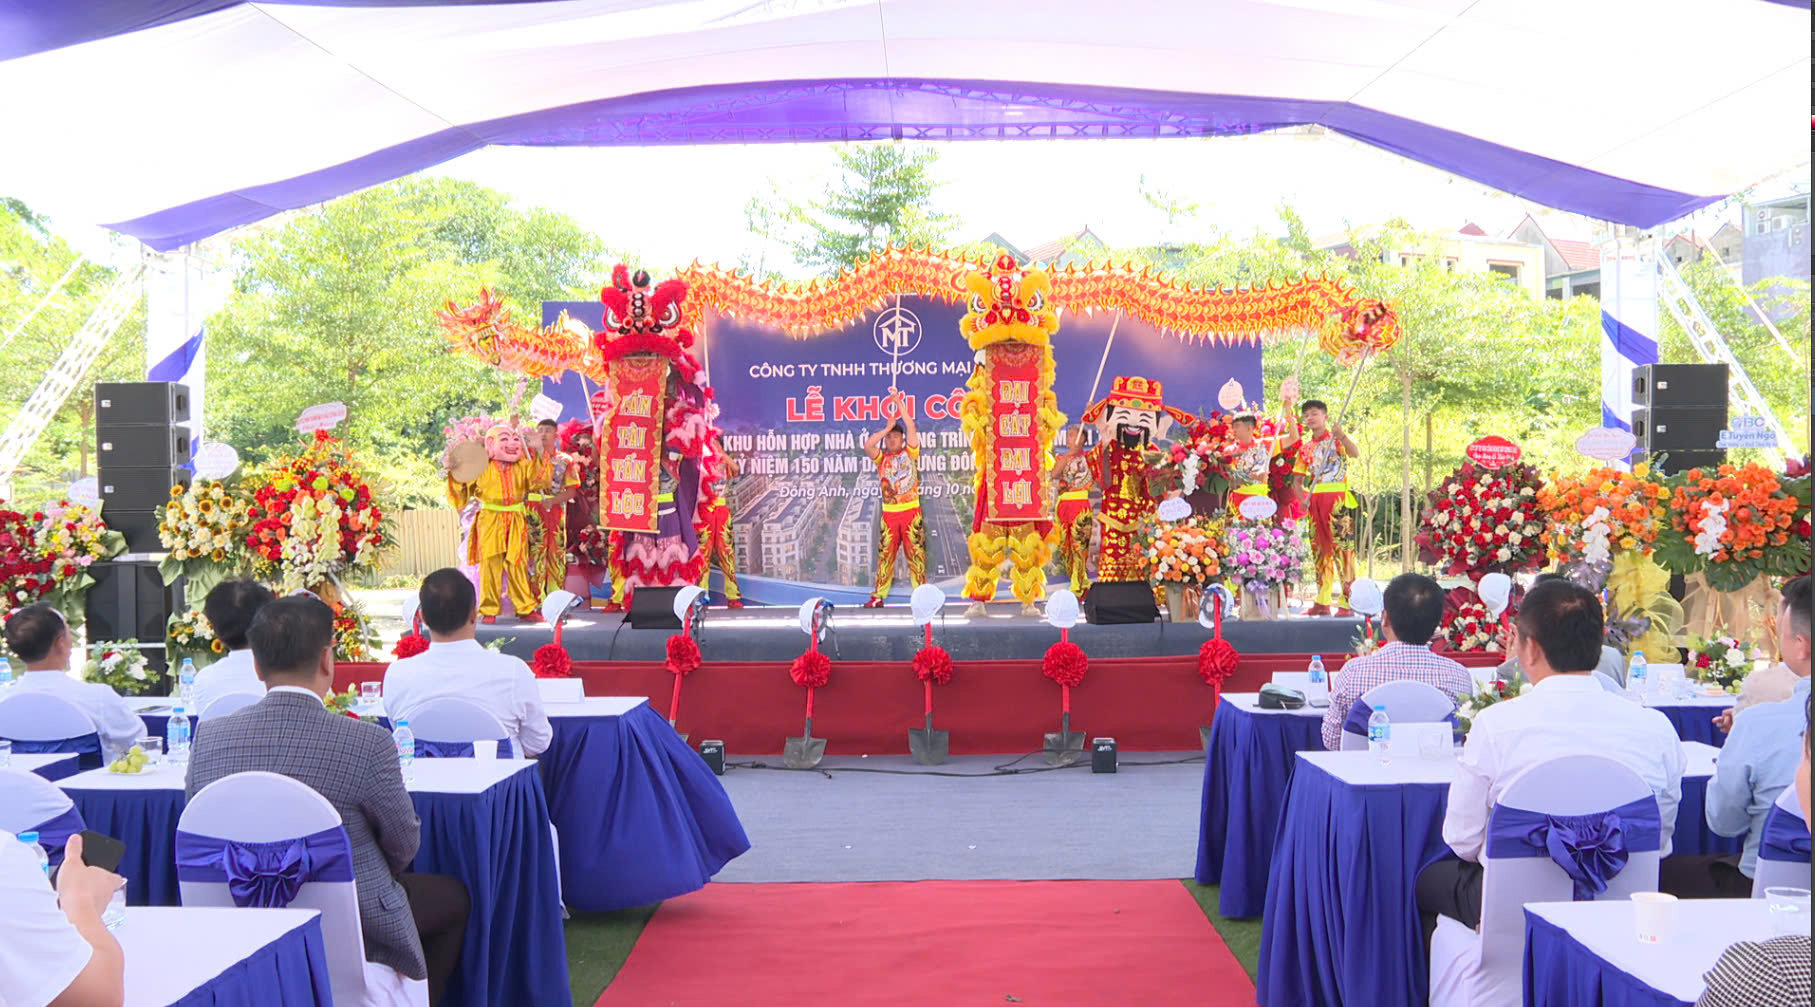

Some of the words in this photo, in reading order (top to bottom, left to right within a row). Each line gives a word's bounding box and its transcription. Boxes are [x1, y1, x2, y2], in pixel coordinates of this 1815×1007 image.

[749, 362, 795, 378] CÔNG
[798, 364, 818, 377] TY
[821, 362, 865, 377] TNHH
[869, 360, 939, 376] THƯƠNG
[942, 361, 972, 377] MẠI
[786, 385, 825, 422] LỄ
[924, 387, 966, 420] CÔ
[999, 380, 1030, 408] ĐẠI
[723, 435, 752, 451] KHU
[757, 429, 787, 450] HỖN
[791, 432, 820, 454] HỢP
[825, 429, 855, 449] NHÀ
[941, 427, 973, 448] TRÌN
[750, 455, 789, 478] NIỆM
[793, 457, 820, 474] 150
[824, 453, 858, 473] NĂM
[1000, 447, 1032, 476] ĐẠI
[819, 485, 849, 499] Anh,
[946, 483, 960, 495] 10
